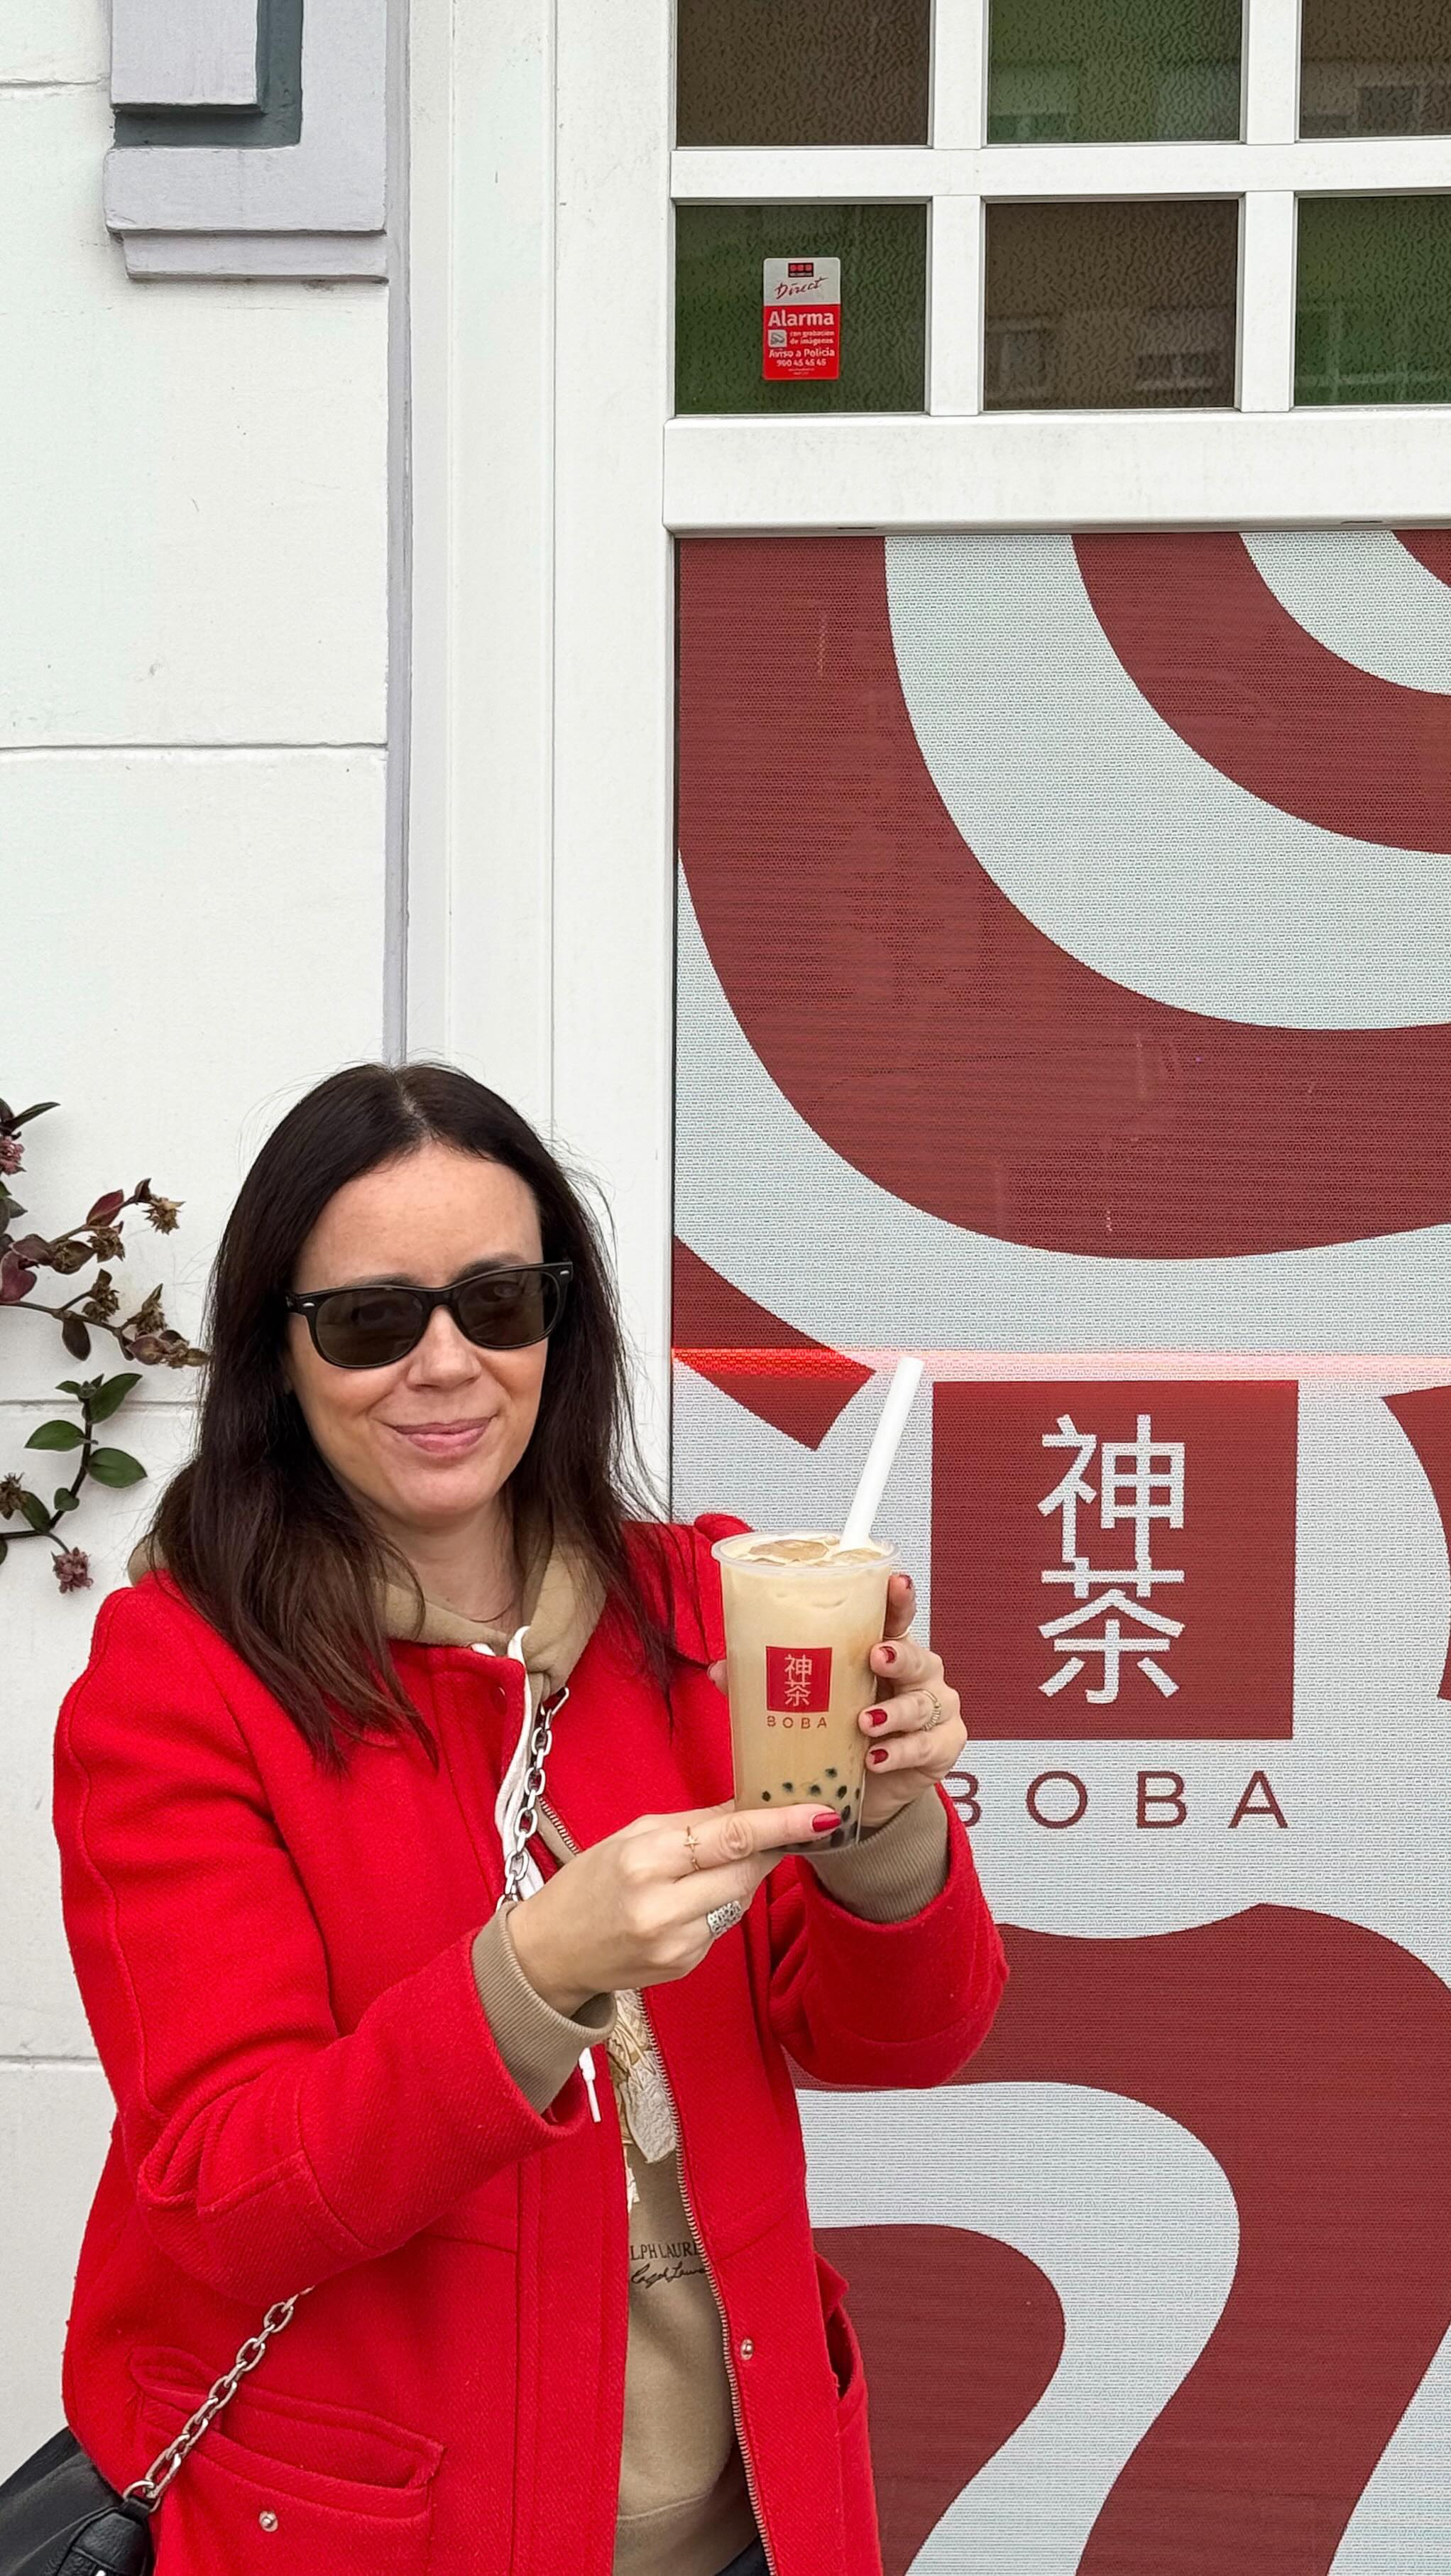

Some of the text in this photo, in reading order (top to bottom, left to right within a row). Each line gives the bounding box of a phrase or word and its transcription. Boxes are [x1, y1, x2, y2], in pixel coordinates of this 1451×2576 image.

[768, 310, 835, 327] Alarma
[769, 349, 794, 359] Aviso
[1037, 1414, 1186, 1704] 神茶
[784, 1654, 813, 1707] 神茶
[766, 1715, 827, 1729] BOBA
[630, 2244, 657, 2260] LPH
